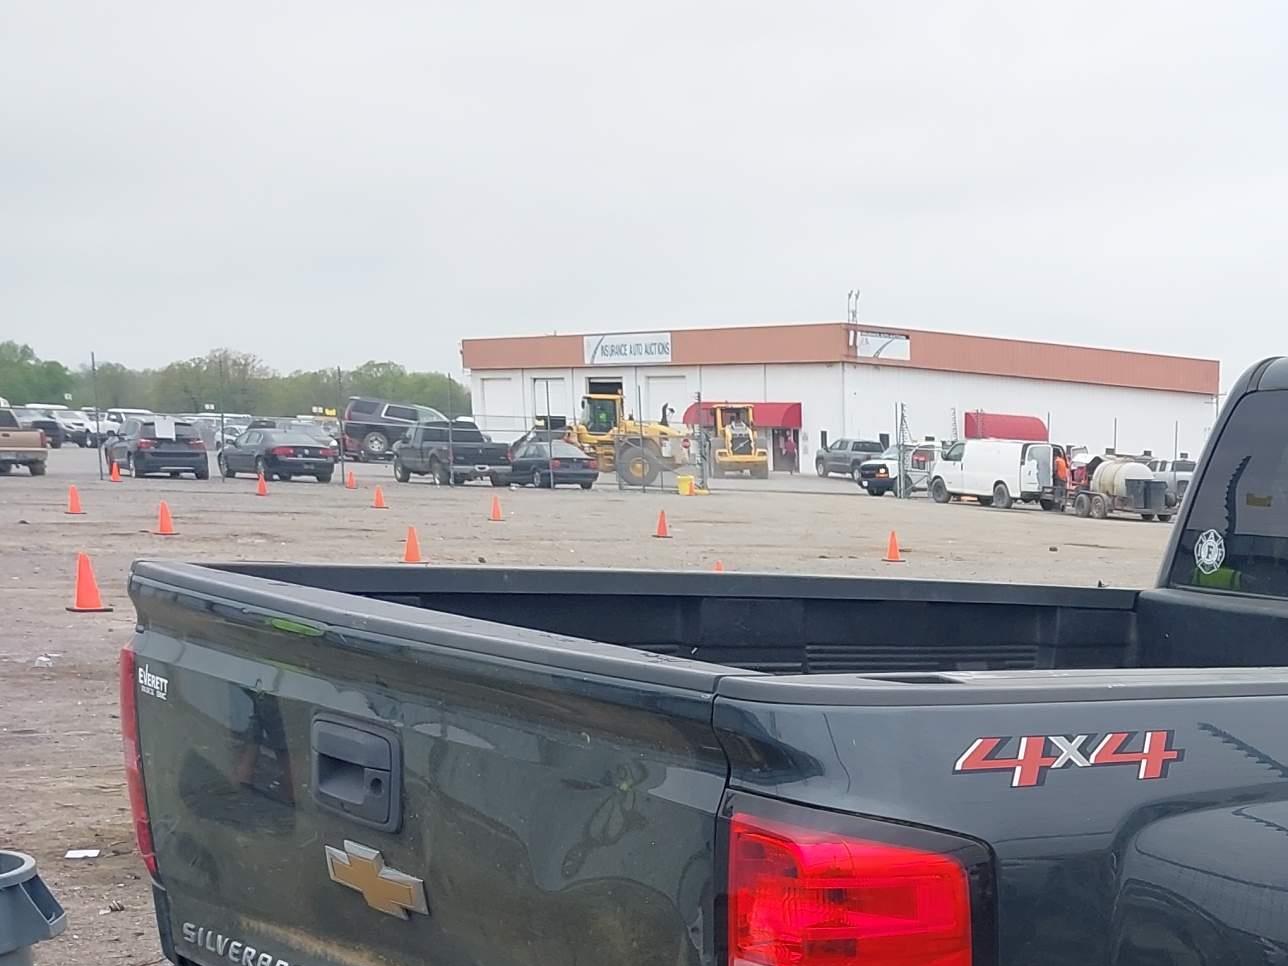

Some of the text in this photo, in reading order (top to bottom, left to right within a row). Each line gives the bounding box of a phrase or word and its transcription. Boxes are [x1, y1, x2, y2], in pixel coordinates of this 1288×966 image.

[629, 343, 643, 356] AUTO
[645, 342, 670, 356] AUCTIONS
[138, 663, 169, 693] EVERETT
